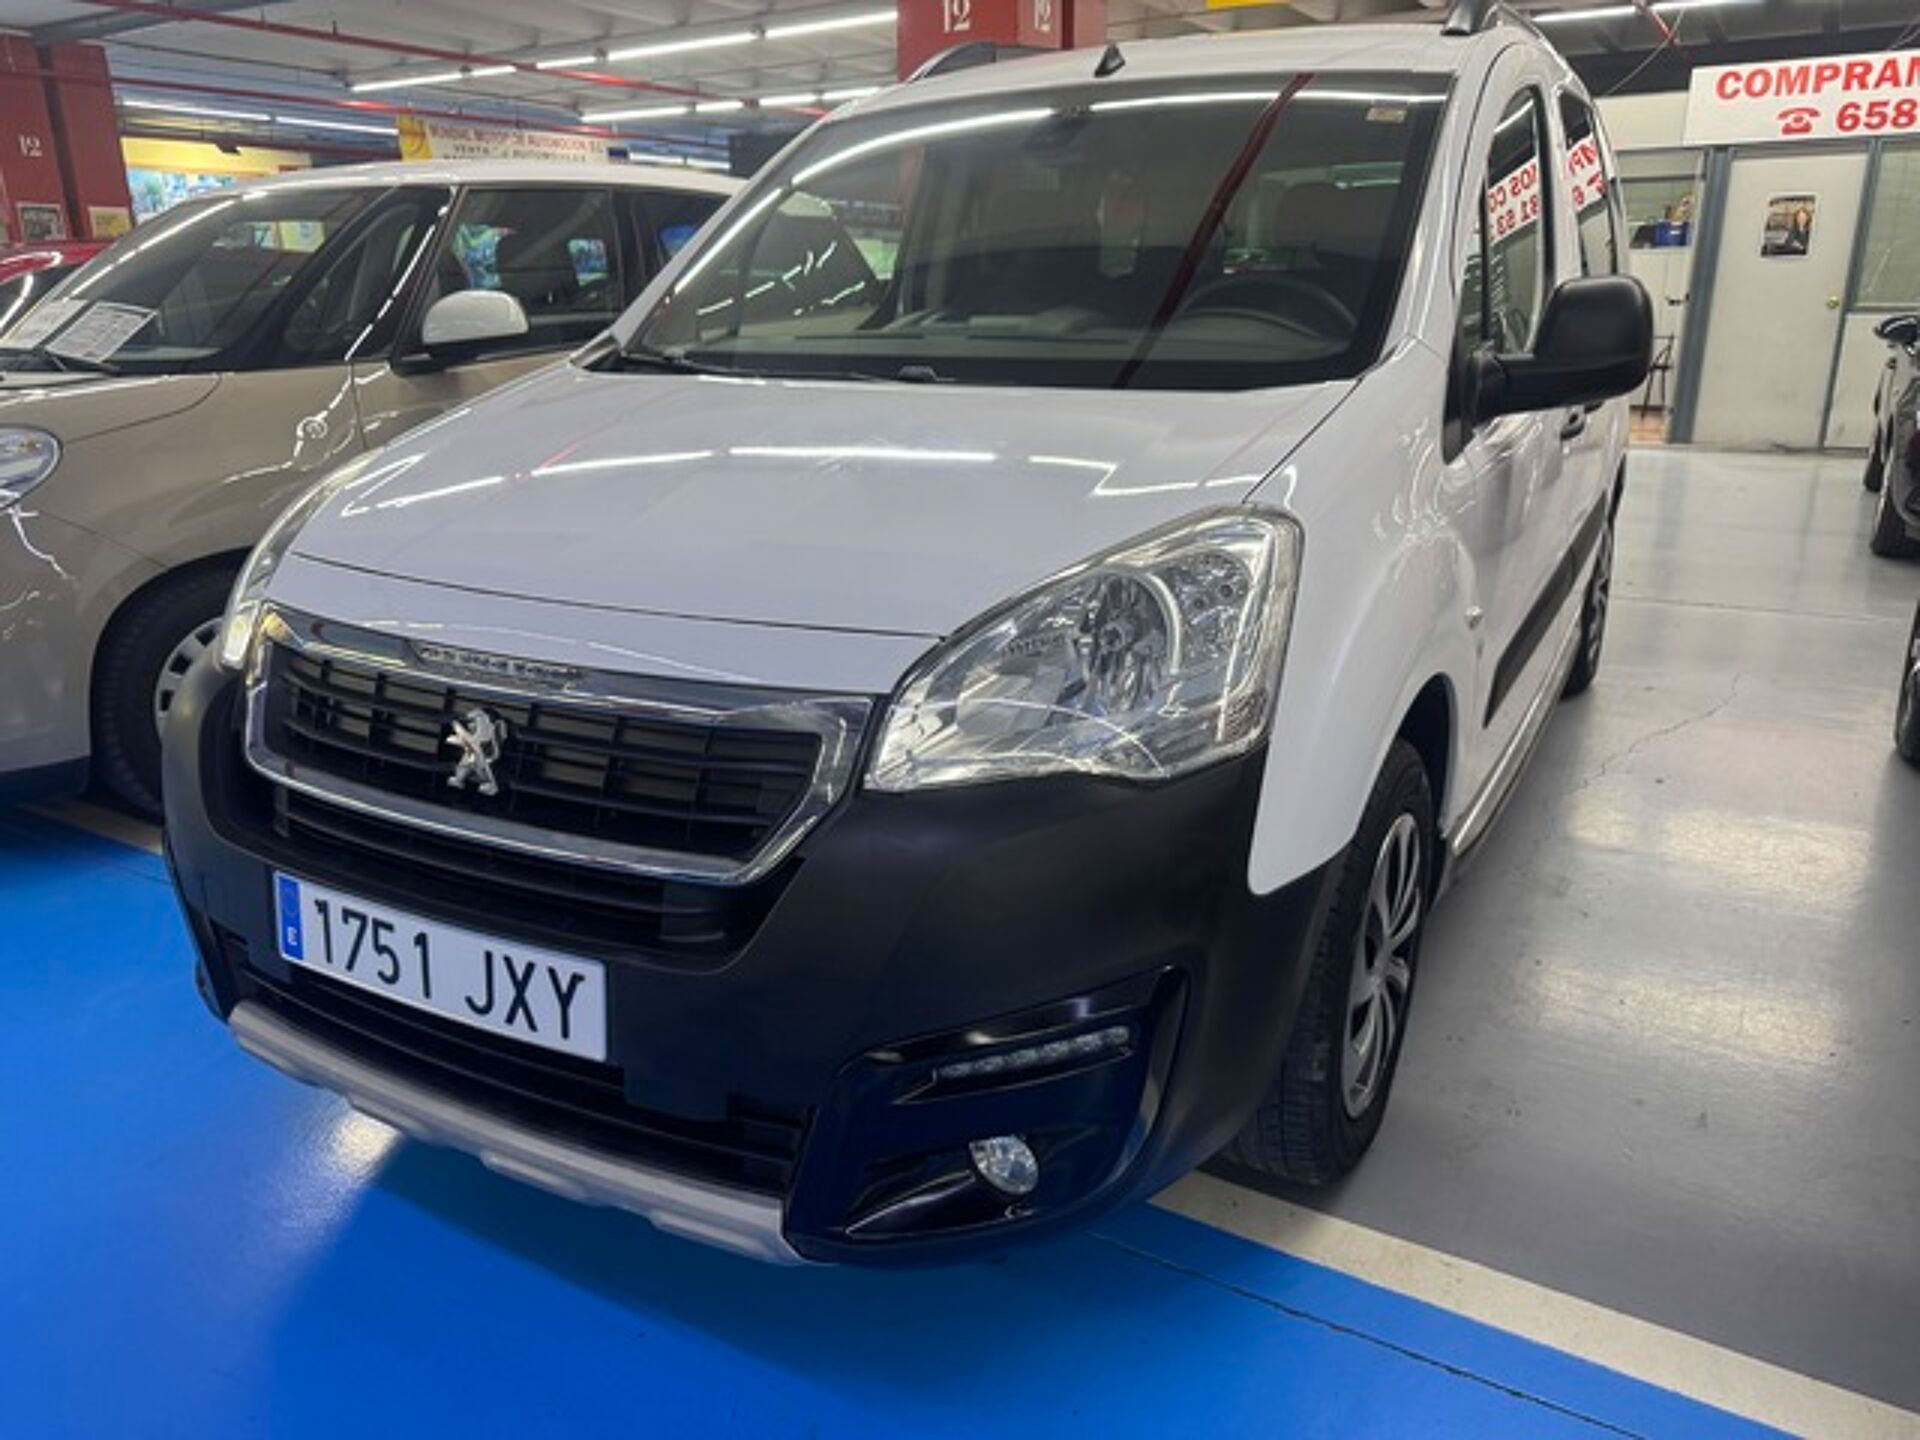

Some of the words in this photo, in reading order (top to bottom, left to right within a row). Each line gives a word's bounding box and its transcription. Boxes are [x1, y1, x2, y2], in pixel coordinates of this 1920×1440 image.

[944, 0, 969, 33] 12
[1034, 0, 1050, 31] 12
[1836, 98, 1918, 132] 658
[18, 135, 43, 157] 12
[287, 926, 298, 946] E
[314, 899, 431, 1000] 1751
[465, 949, 586, 1040] JXY
